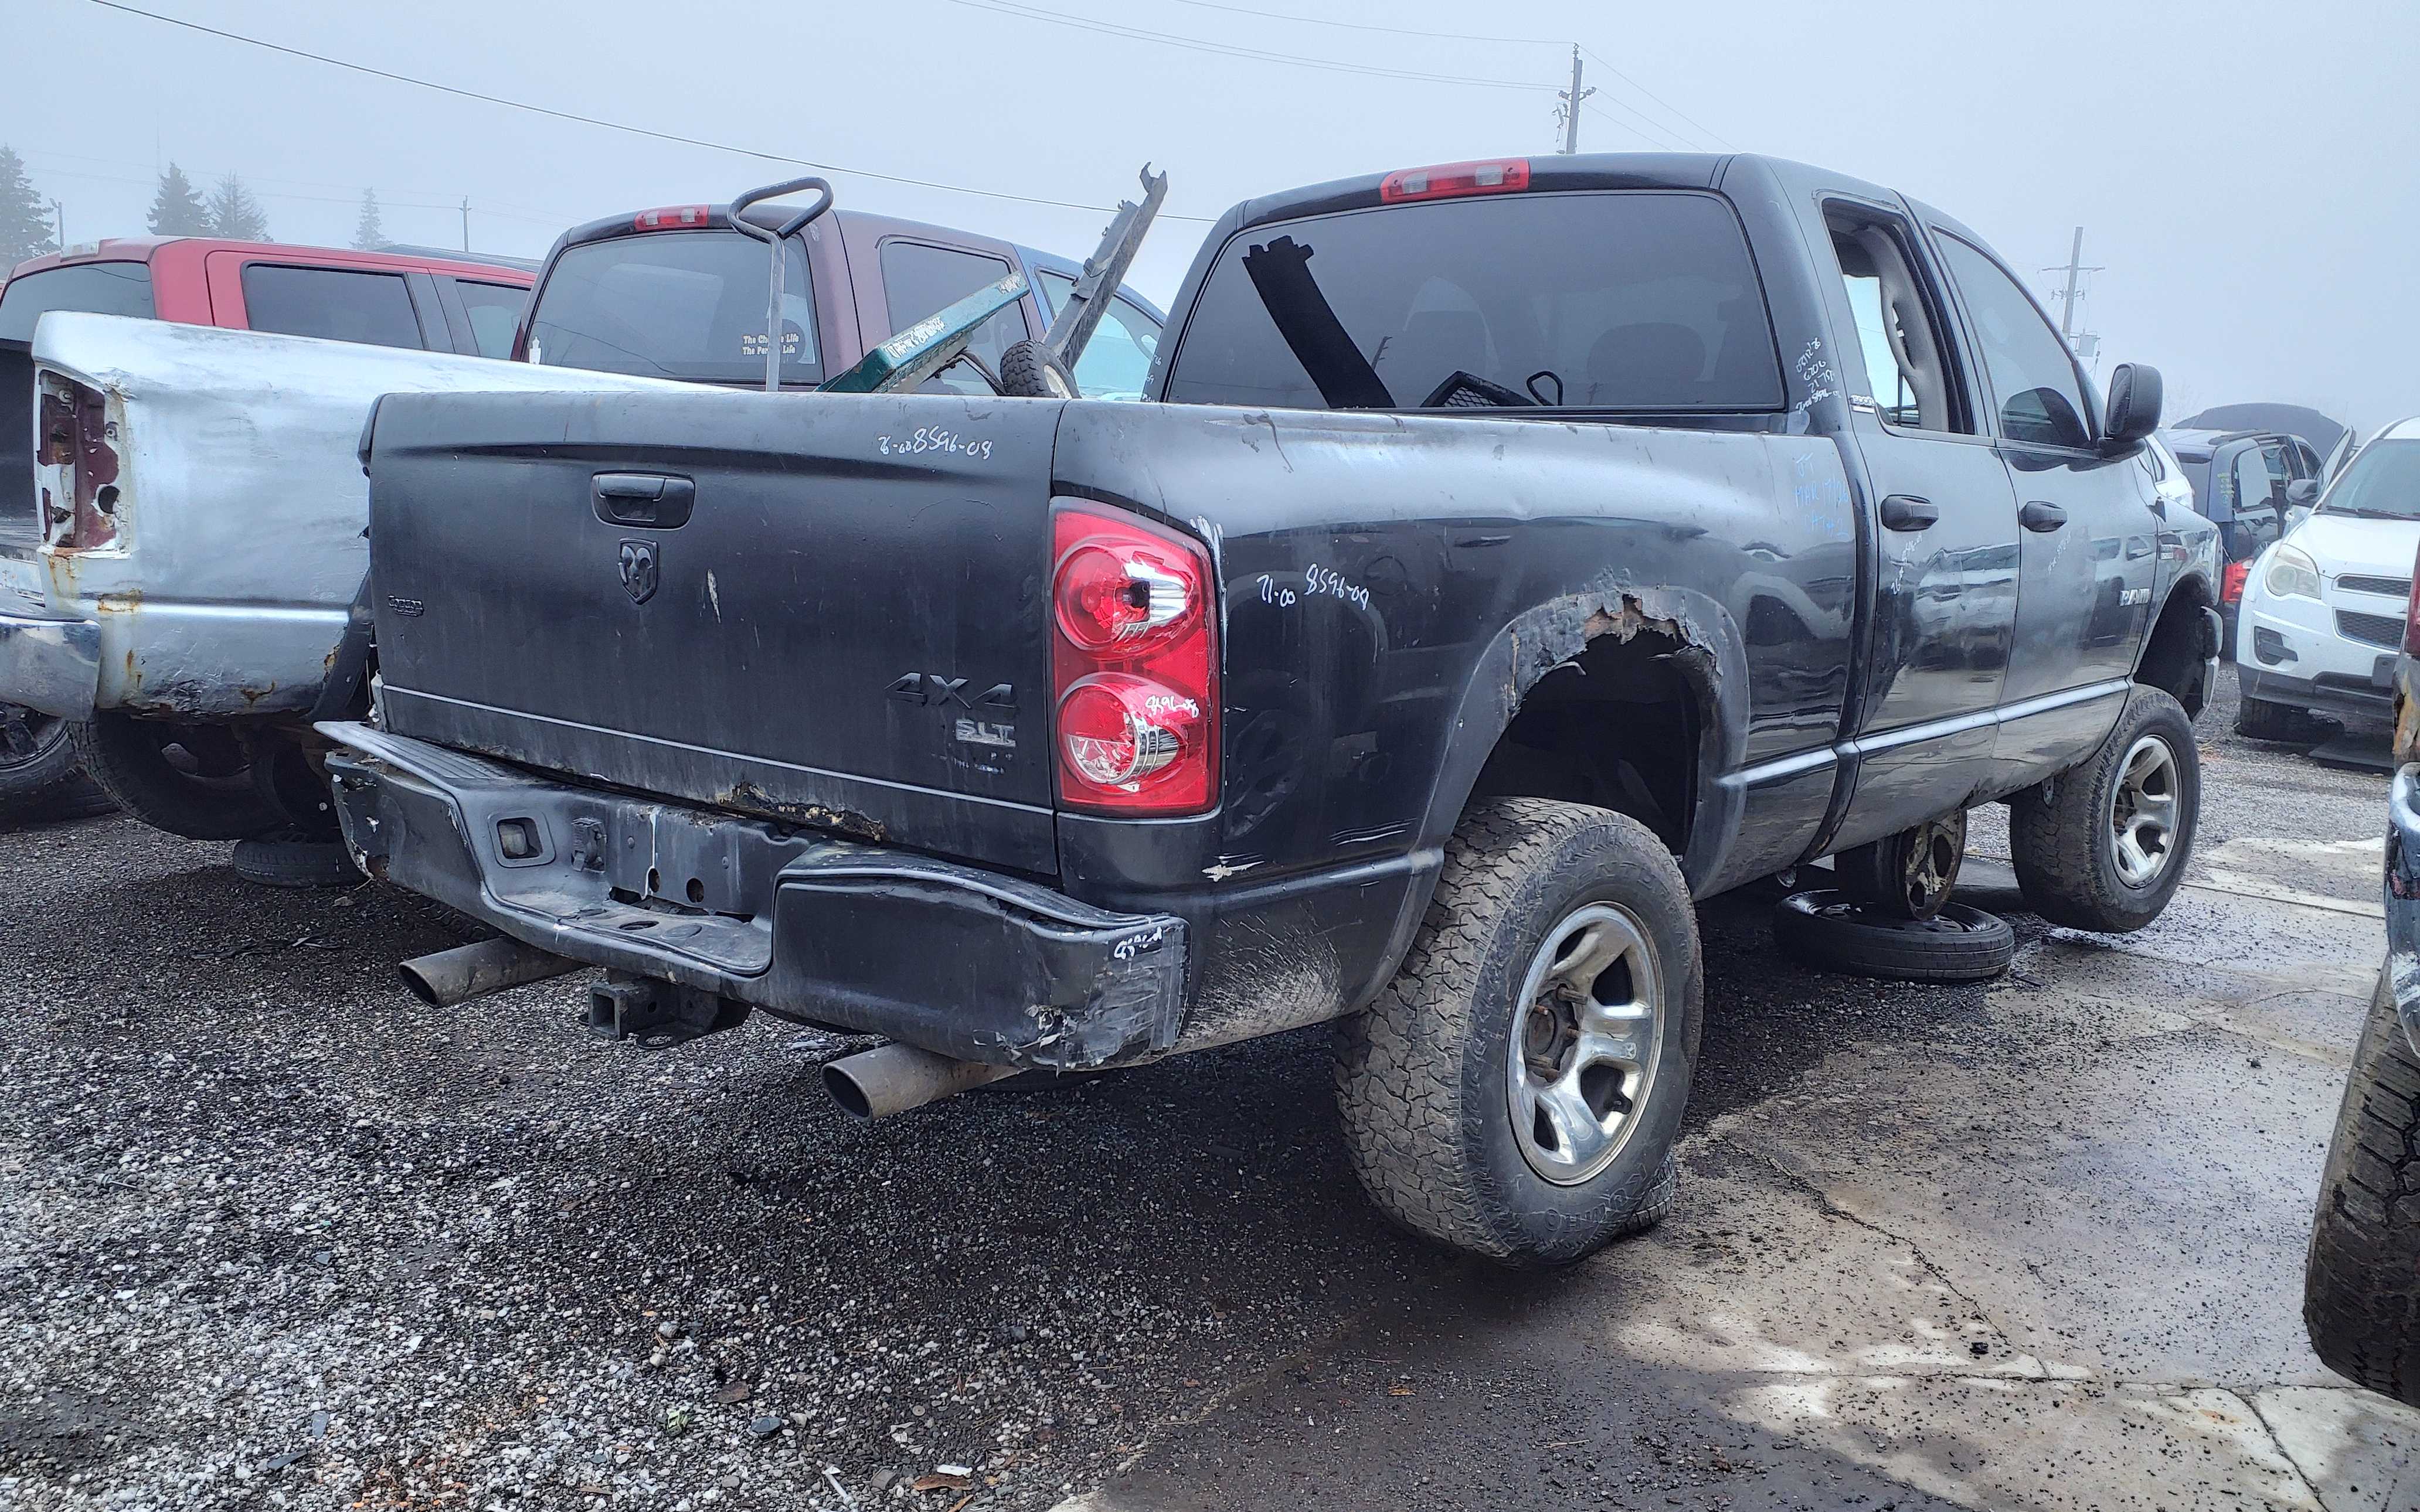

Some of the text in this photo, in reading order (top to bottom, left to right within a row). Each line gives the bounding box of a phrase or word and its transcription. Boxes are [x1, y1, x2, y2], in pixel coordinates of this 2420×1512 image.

[786, 333, 799, 343] Life
[742, 346, 756, 356] The
[782, 344, 796, 354] Life
